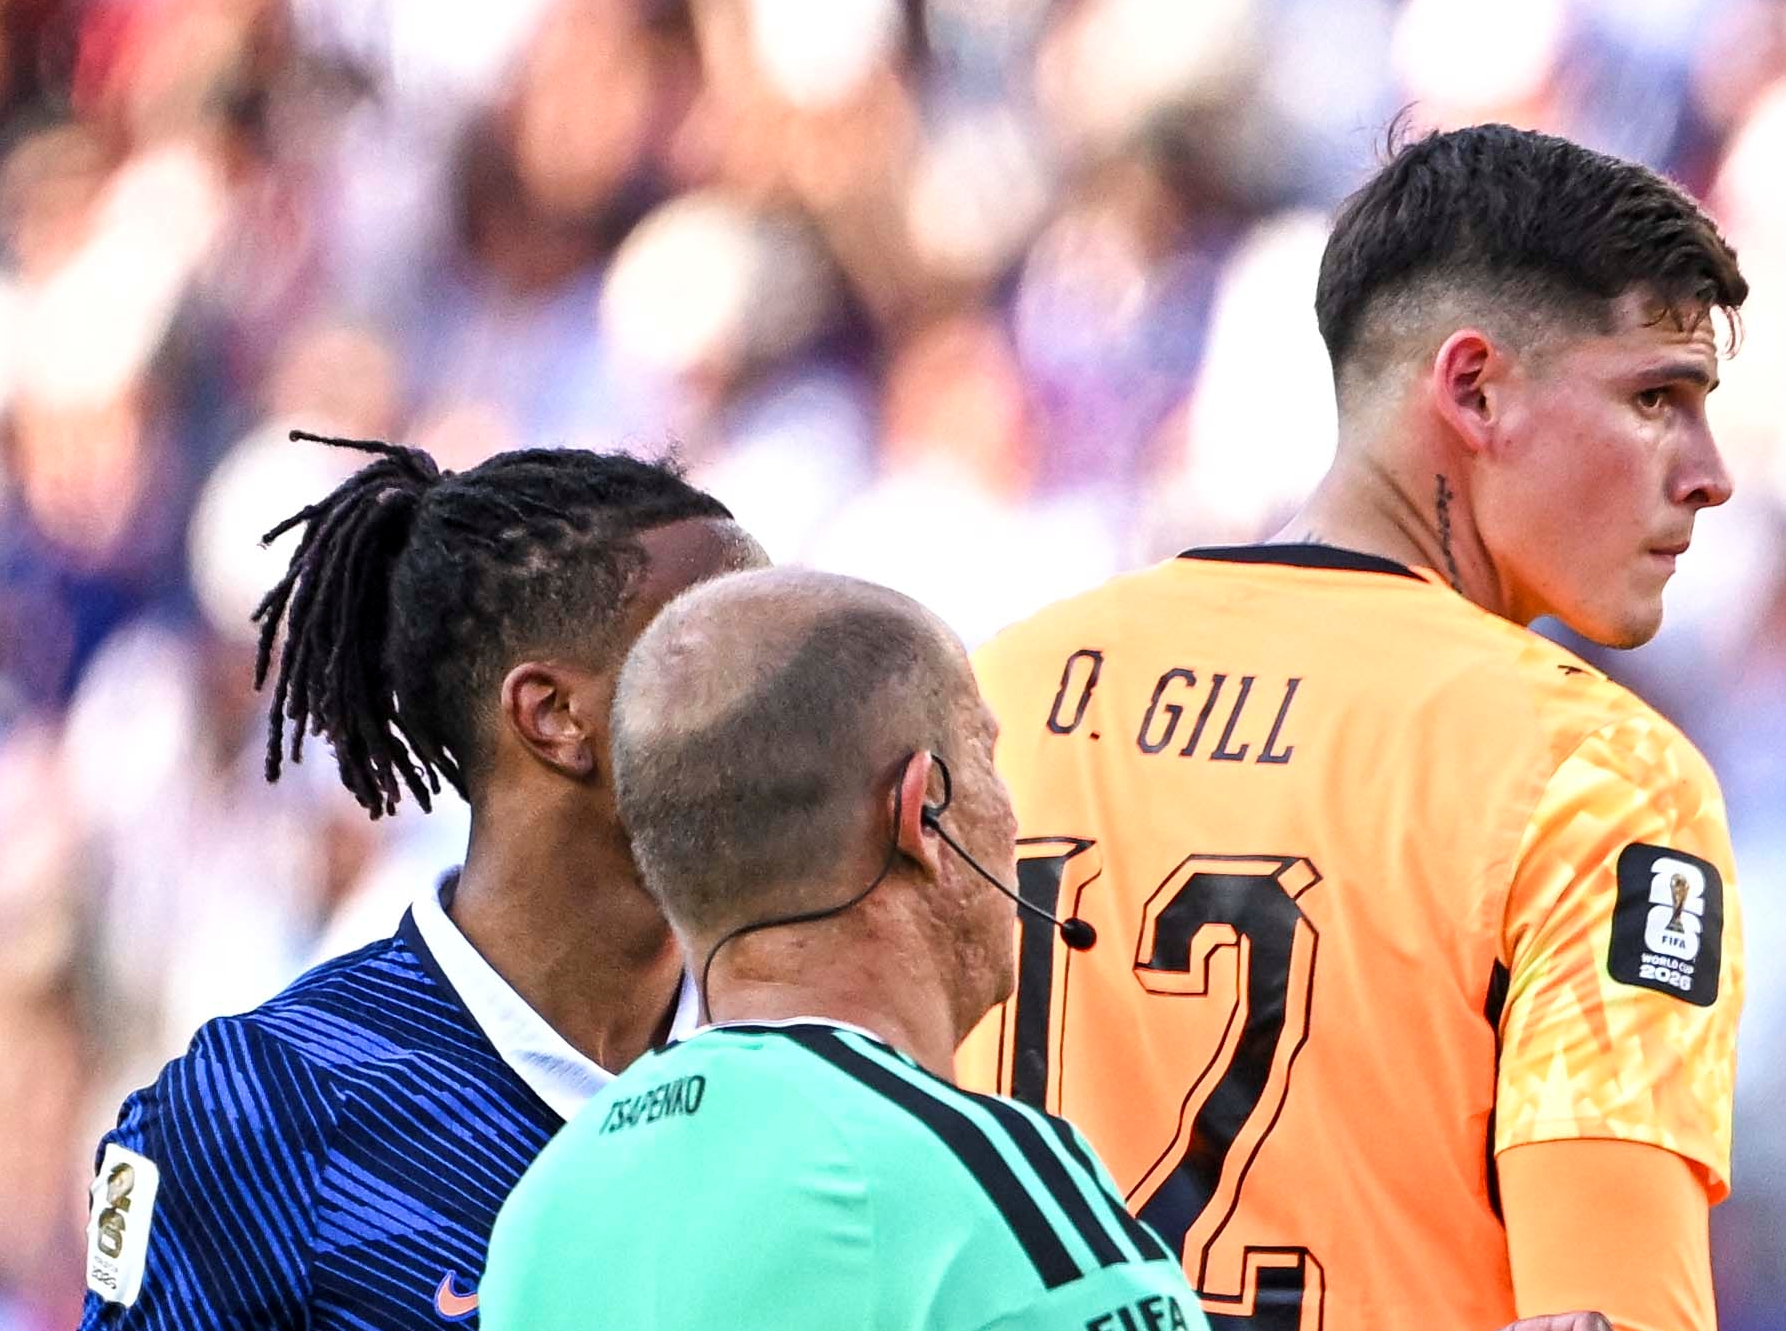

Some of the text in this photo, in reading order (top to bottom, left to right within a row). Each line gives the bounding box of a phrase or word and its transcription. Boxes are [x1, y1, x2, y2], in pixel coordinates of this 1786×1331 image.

[1046, 648, 1304, 765] O. GILL
[1661, 934, 1687, 950] FIFA
[1641, 952, 1695, 975] WORLD CUP
[1638, 964, 1693, 992] 2026
